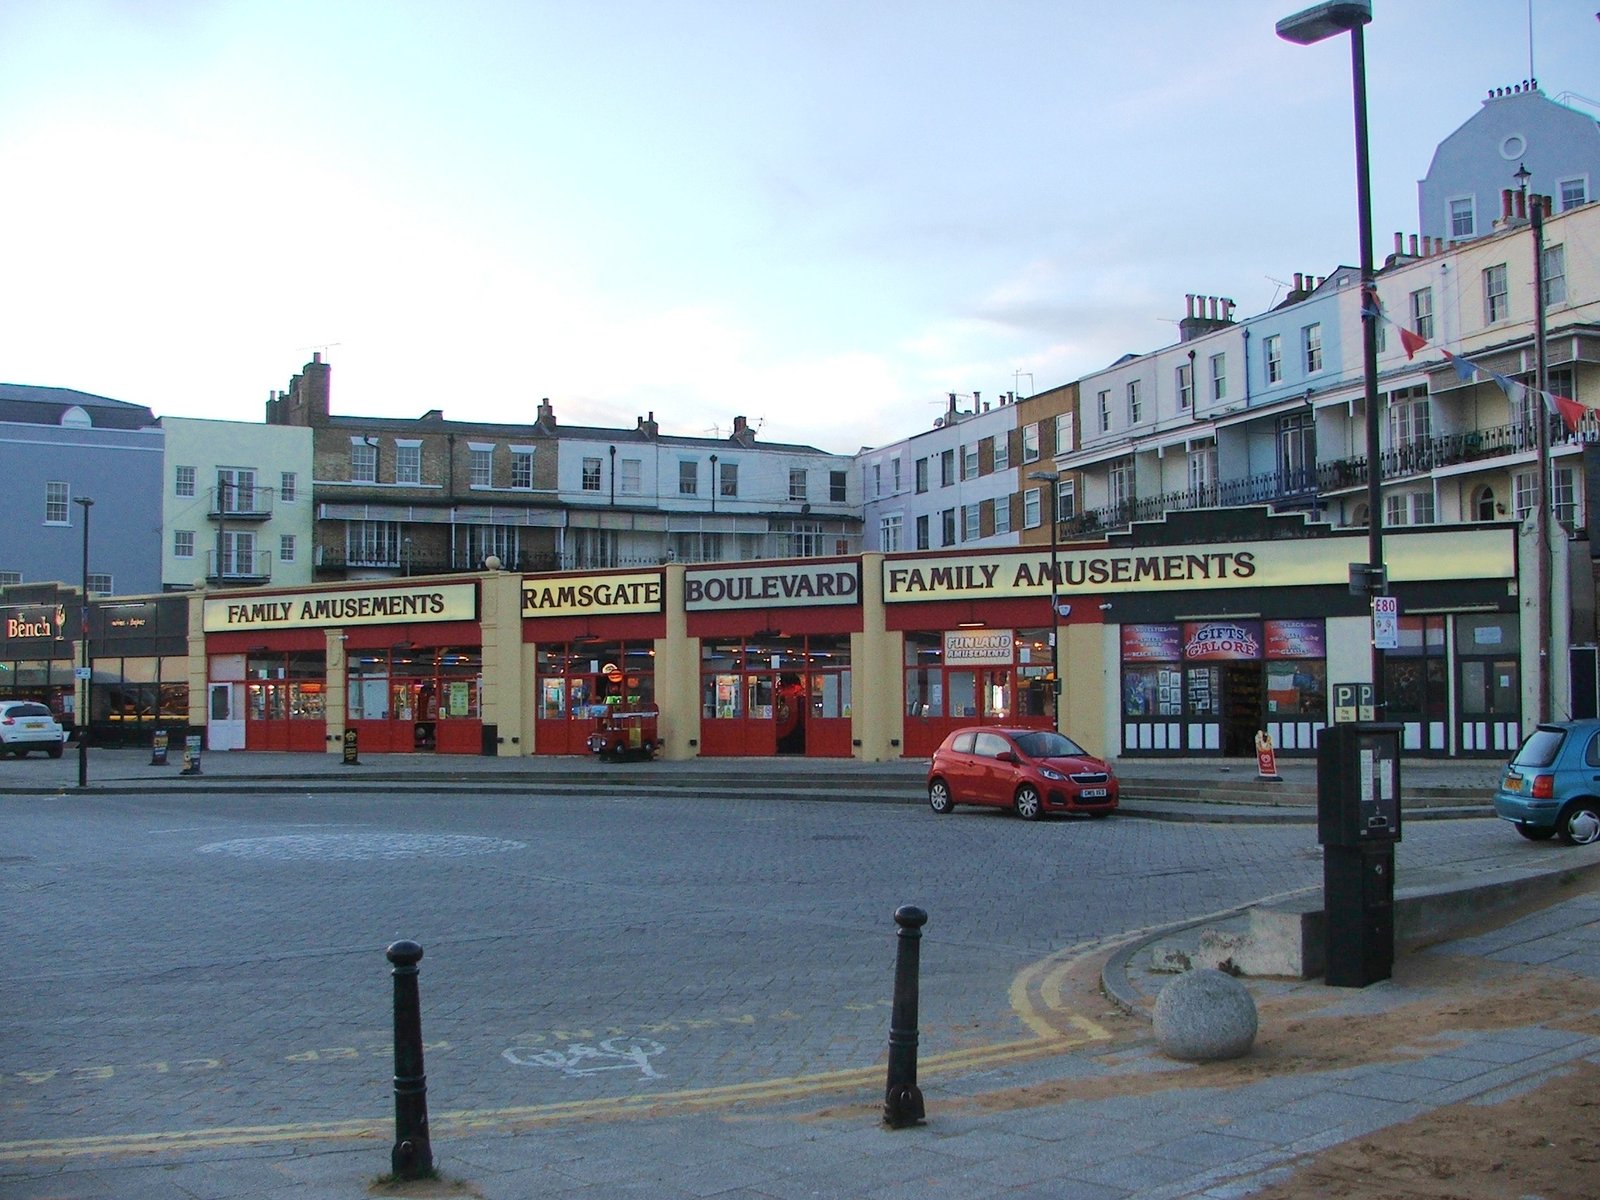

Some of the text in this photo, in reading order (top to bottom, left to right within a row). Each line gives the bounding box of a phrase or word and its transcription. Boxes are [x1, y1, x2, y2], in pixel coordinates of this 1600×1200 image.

[889, 552, 1256, 593] FAMILY AMUSEMENTS
[522, 582, 661, 609] RAMSGATE
[686, 572, 857, 602] BOULEVARD
[228, 593, 444, 623] FAMILY AMUSEMENTS
[1375, 599, 1395, 612] £80
[8, 615, 51, 638] Bench
[1197, 627, 1244, 641] GIFTS
[947, 635, 1011, 650] FUNLAND
[1187, 640, 1255, 658] GALORE
[947, 649, 1011, 659] AMUSEMENTS
[1338, 687, 1351, 707] P
[1361, 686, 1371, 705] P
